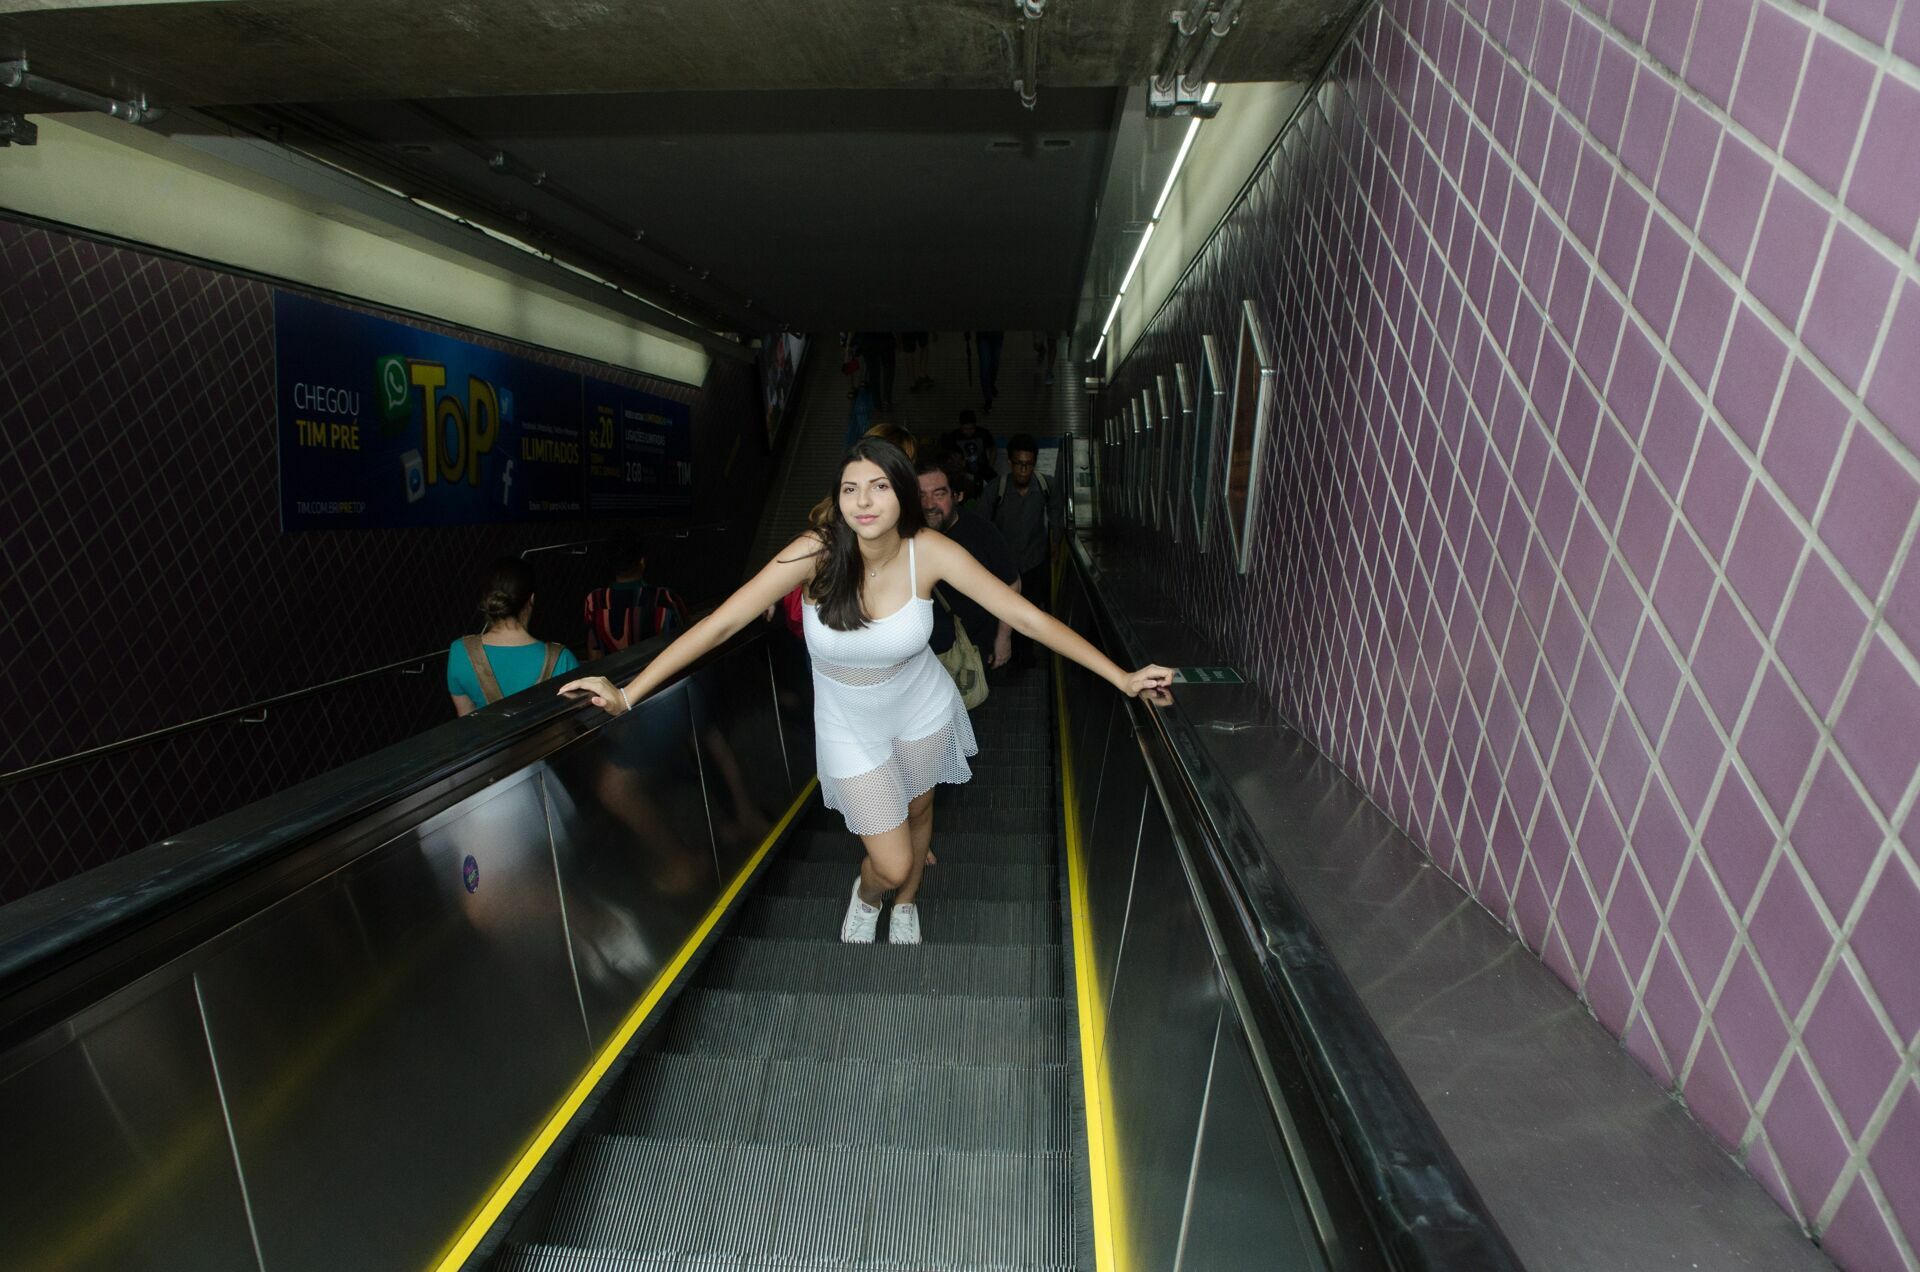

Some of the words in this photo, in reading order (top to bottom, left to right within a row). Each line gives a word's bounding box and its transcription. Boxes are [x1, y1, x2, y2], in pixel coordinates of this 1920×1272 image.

[294, 382, 360, 416] CHEGOU
[296, 419, 327, 447] TIM
[331, 418, 360, 450] PRÉ
[522, 437, 579, 464] ILIMITADOS
